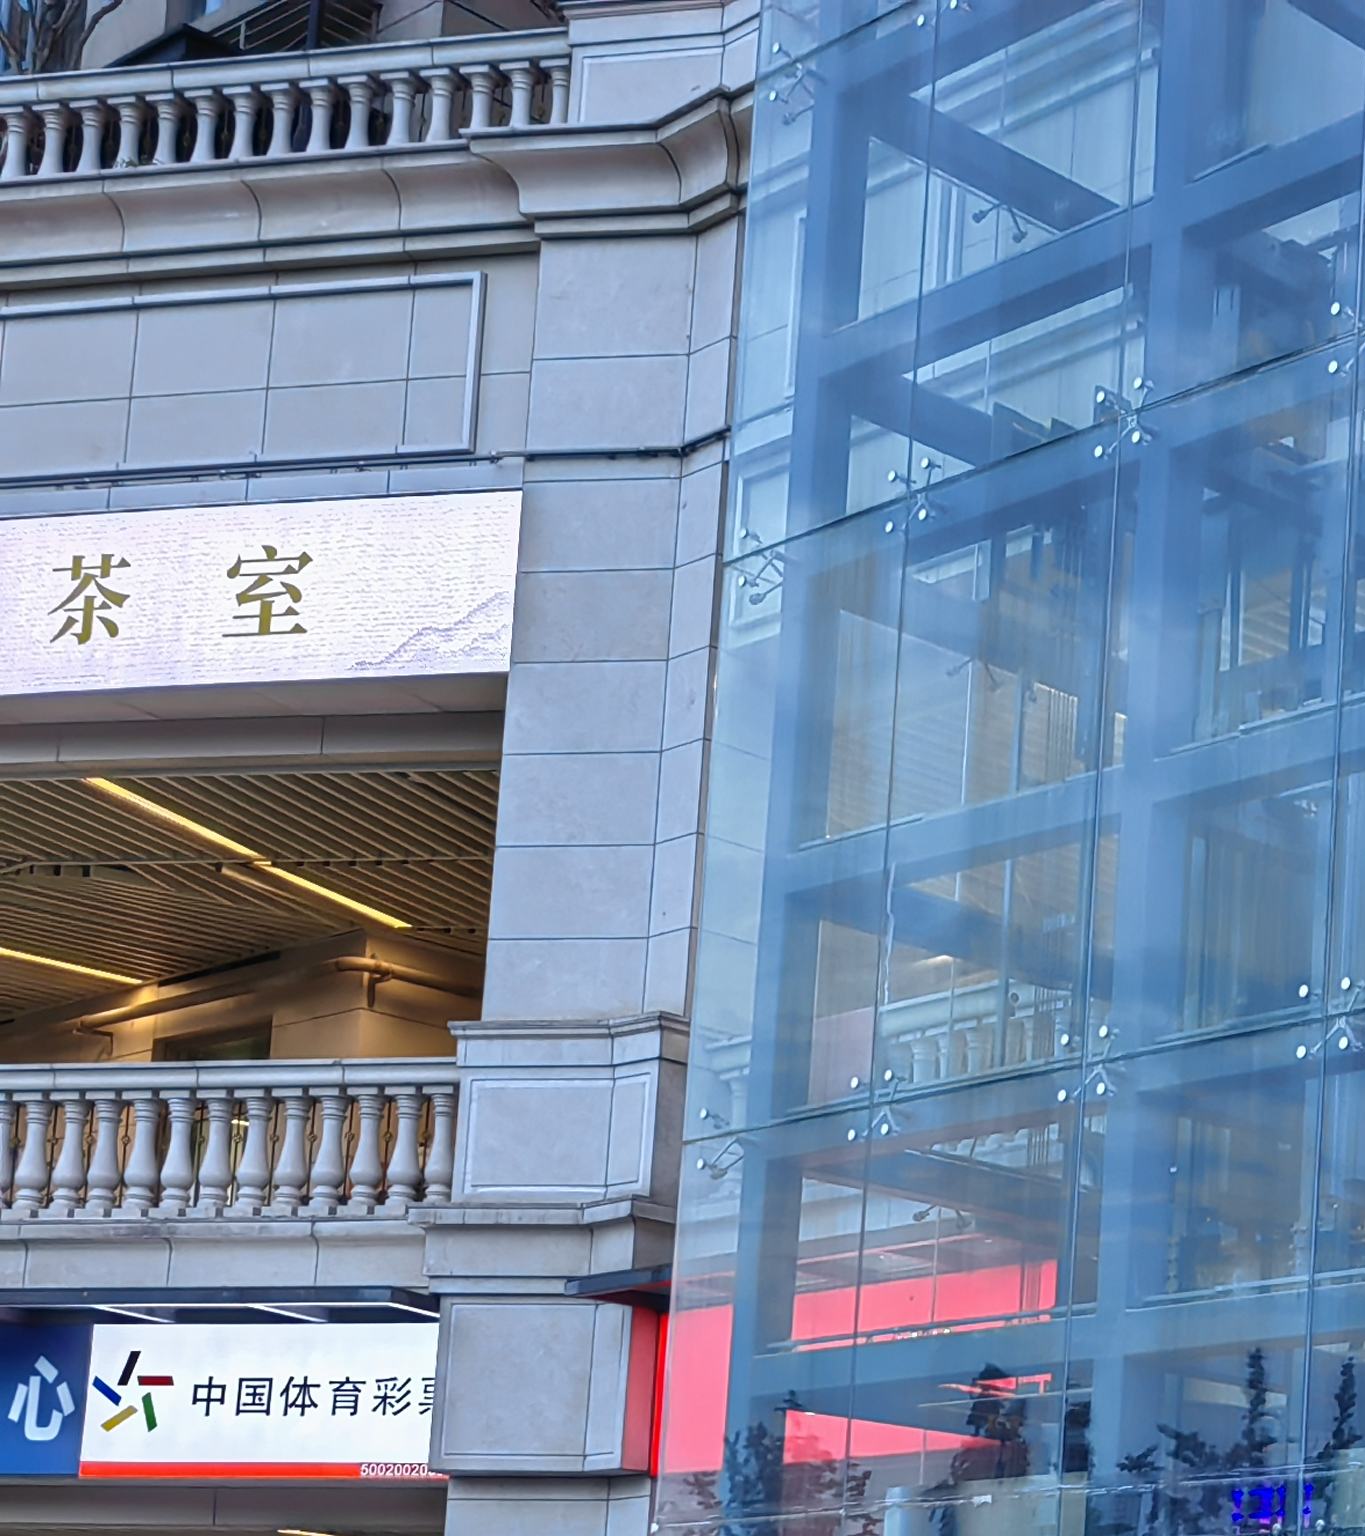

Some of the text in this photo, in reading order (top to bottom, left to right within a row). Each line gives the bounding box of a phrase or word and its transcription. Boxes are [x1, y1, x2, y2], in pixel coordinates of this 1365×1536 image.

[49, 545, 313, 644] 茶室
[9, 1355, 75, 1442] 心
[360, 1463, 442, 1477] 50020020
